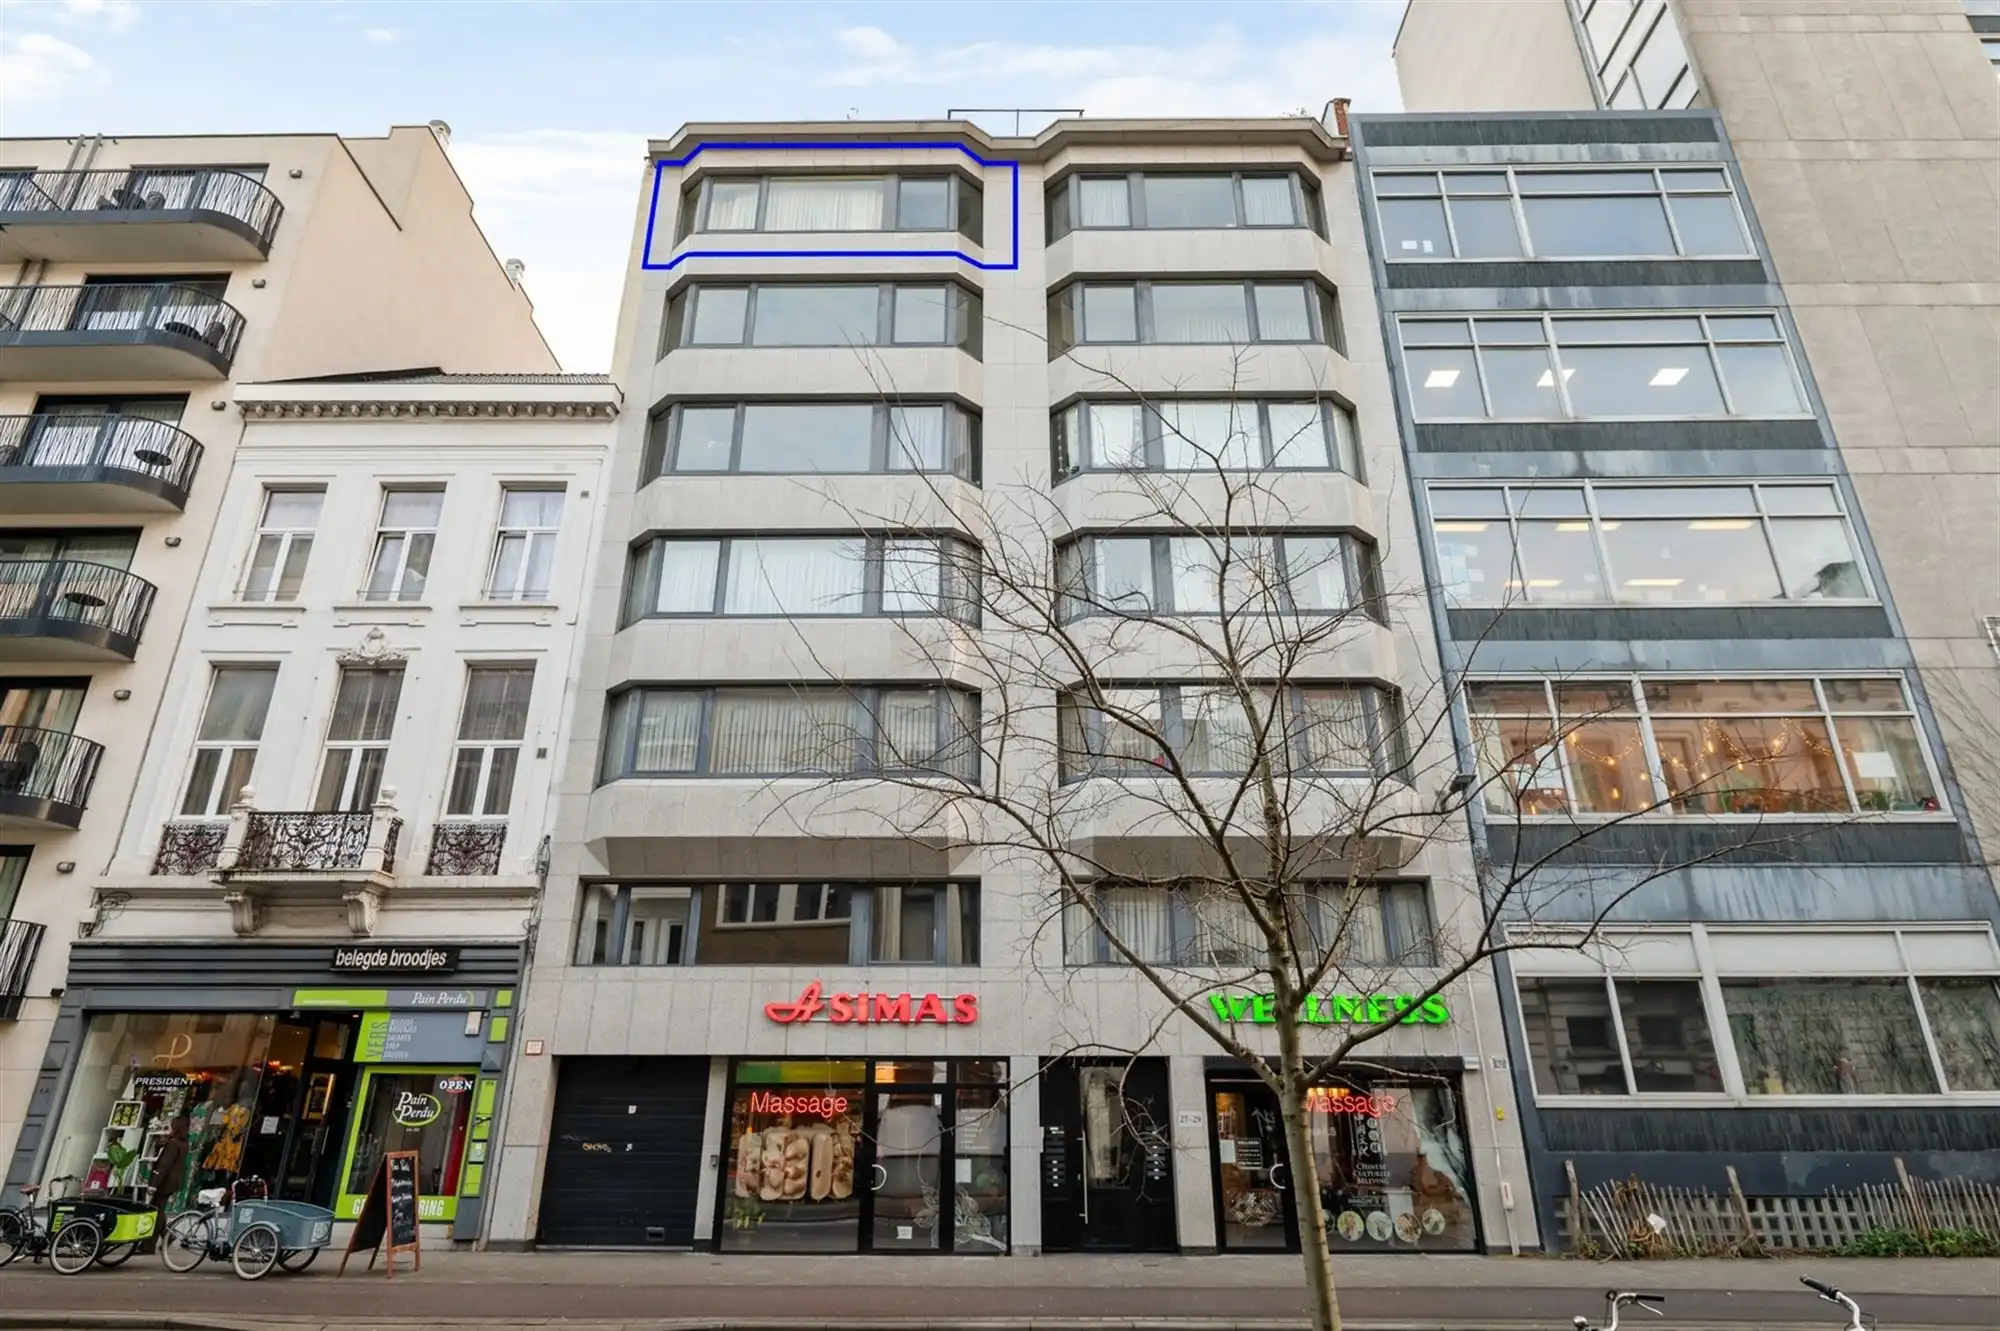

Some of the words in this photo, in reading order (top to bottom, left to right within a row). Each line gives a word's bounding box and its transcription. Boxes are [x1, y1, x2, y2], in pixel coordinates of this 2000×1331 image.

[336, 949, 388, 970] belegde
[389, 949, 447, 970] broodjes
[412, 991, 435, 1005] Pain
[436, 991, 468, 1005] Perdu
[1208, 992, 1450, 1025] WELNESS
[135, 1077, 195, 1085] PRESIDENT
[440, 1080, 473, 1091] OPEN
[395, 1091, 427, 1111] Pain
[750, 1091, 848, 1118] Massage
[396, 1105, 434, 1123] Perdu
